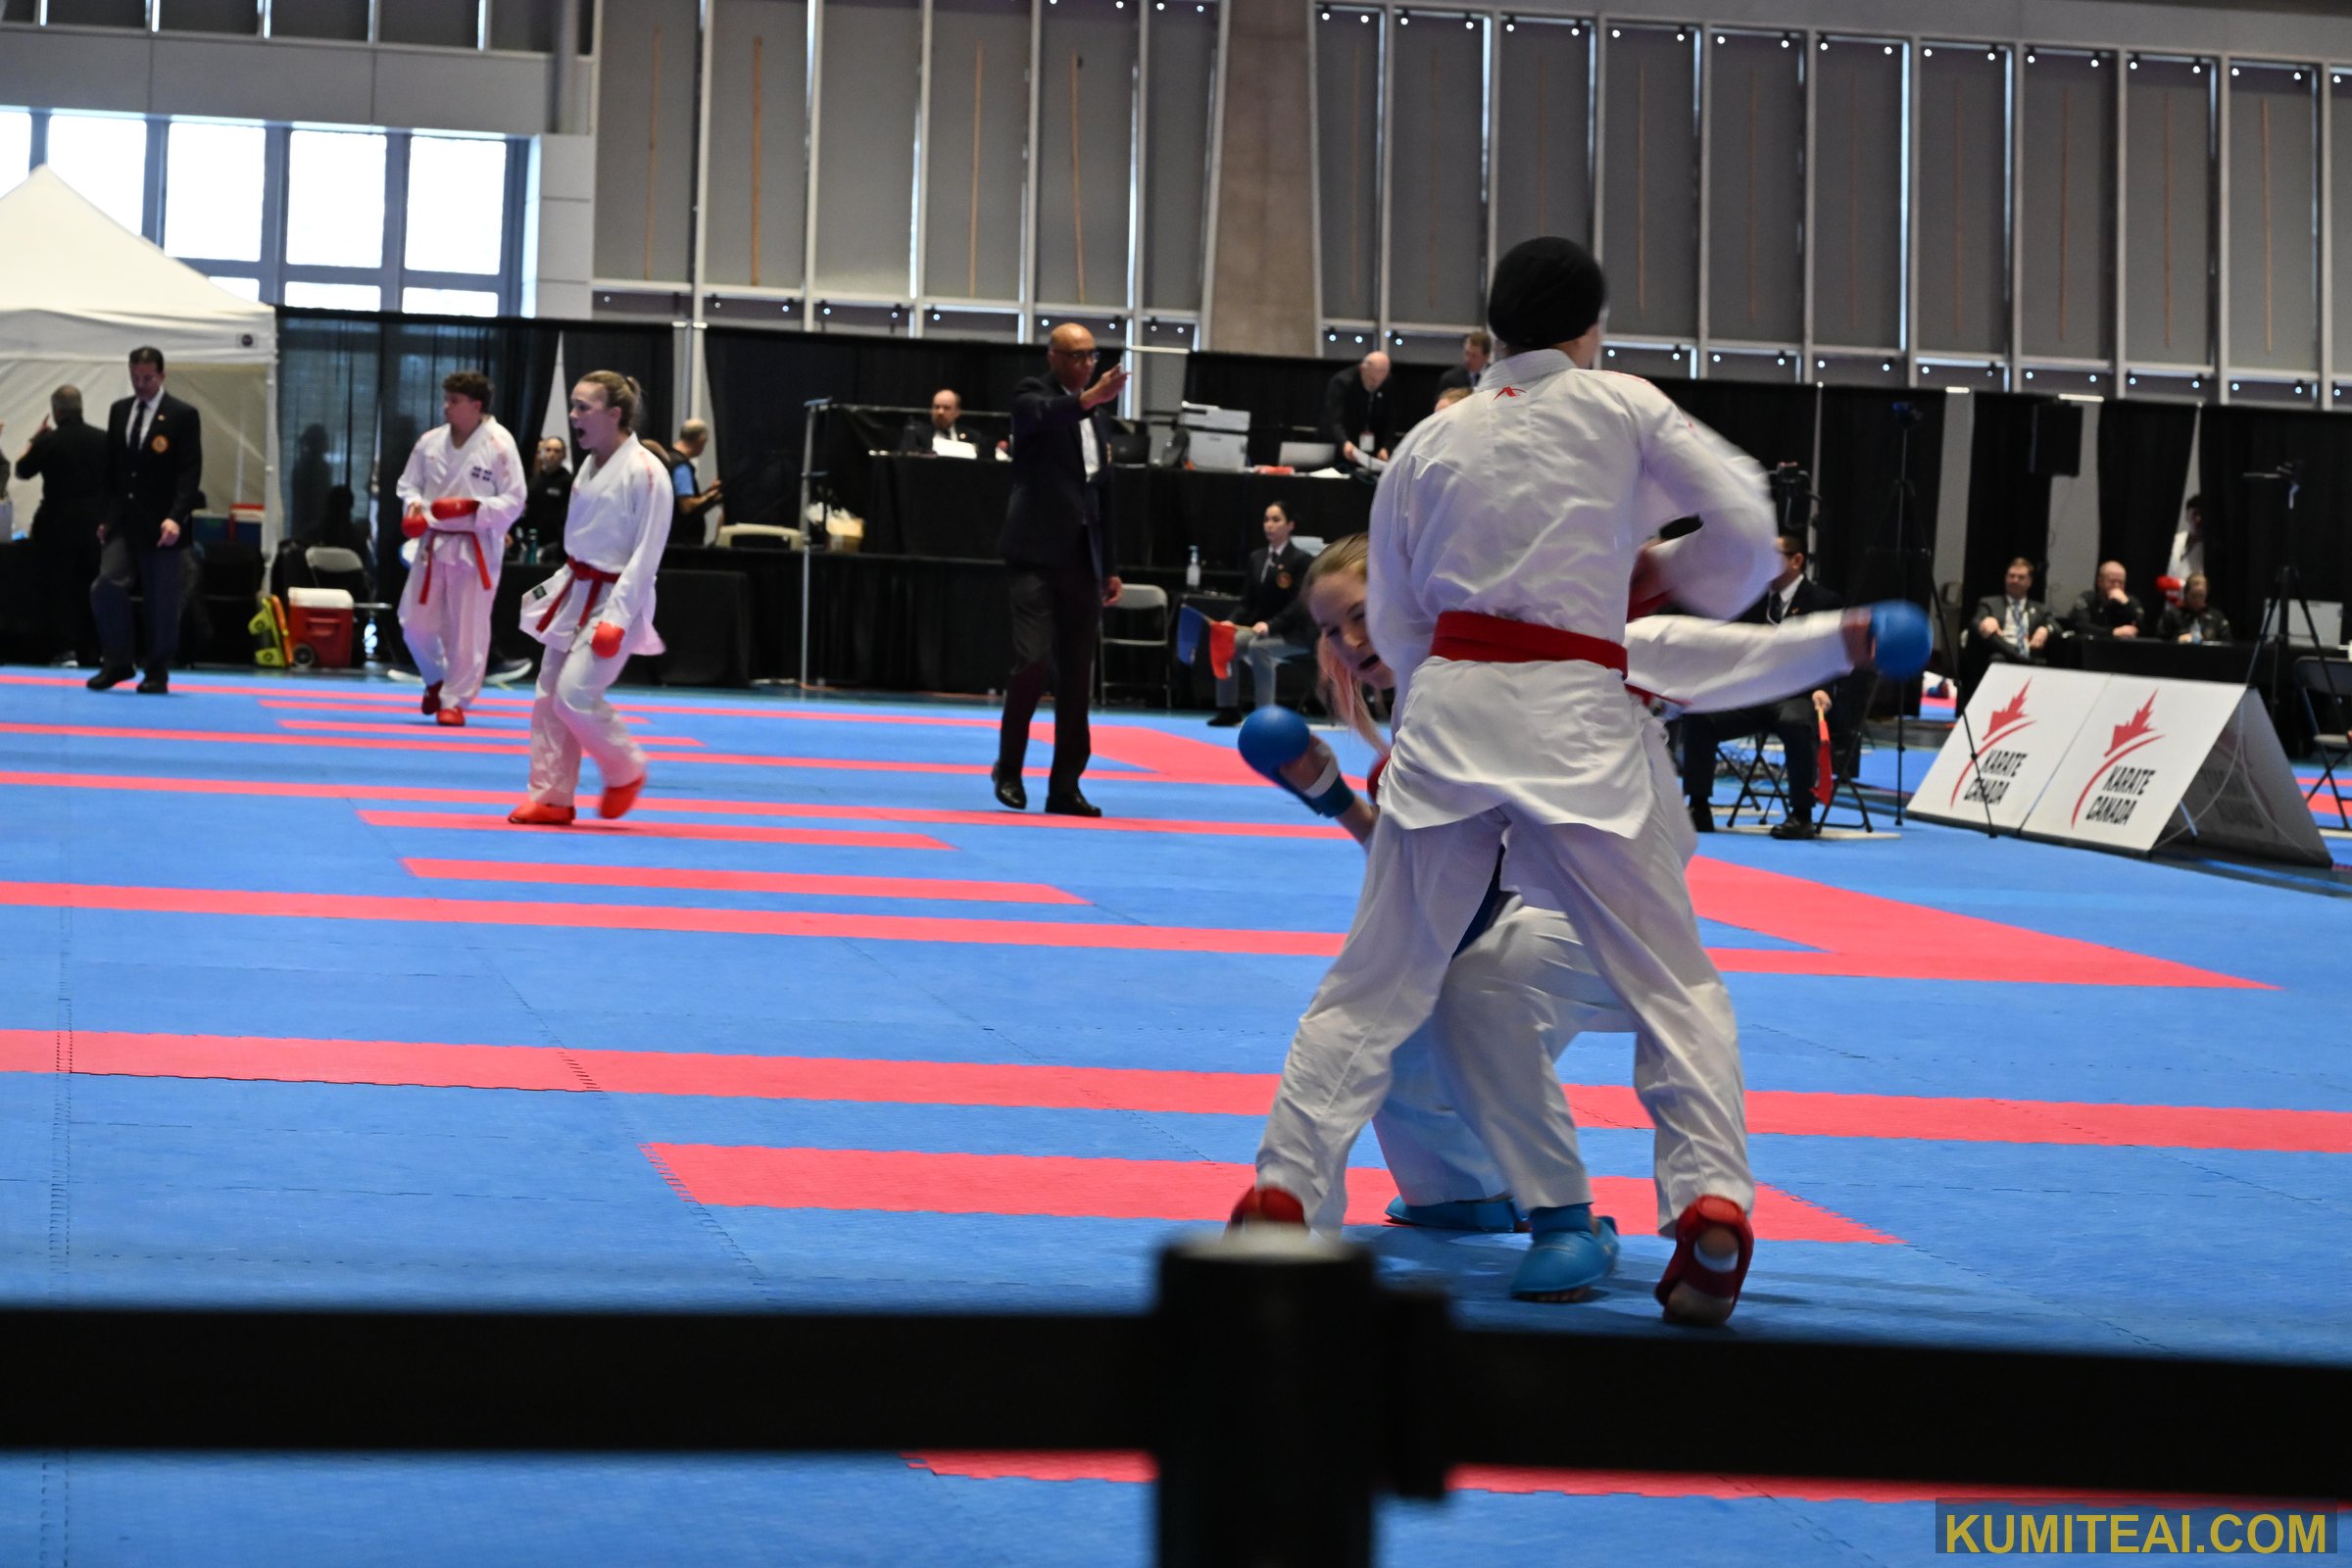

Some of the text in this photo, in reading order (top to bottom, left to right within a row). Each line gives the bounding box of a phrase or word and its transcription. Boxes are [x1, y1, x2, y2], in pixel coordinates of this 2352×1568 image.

[1981, 749, 2028, 778] KARATE
[1964, 777, 2010, 806] CANADA
[2102, 765, 2156, 796] KARATE
[2085, 795, 2137, 826] CANADA
